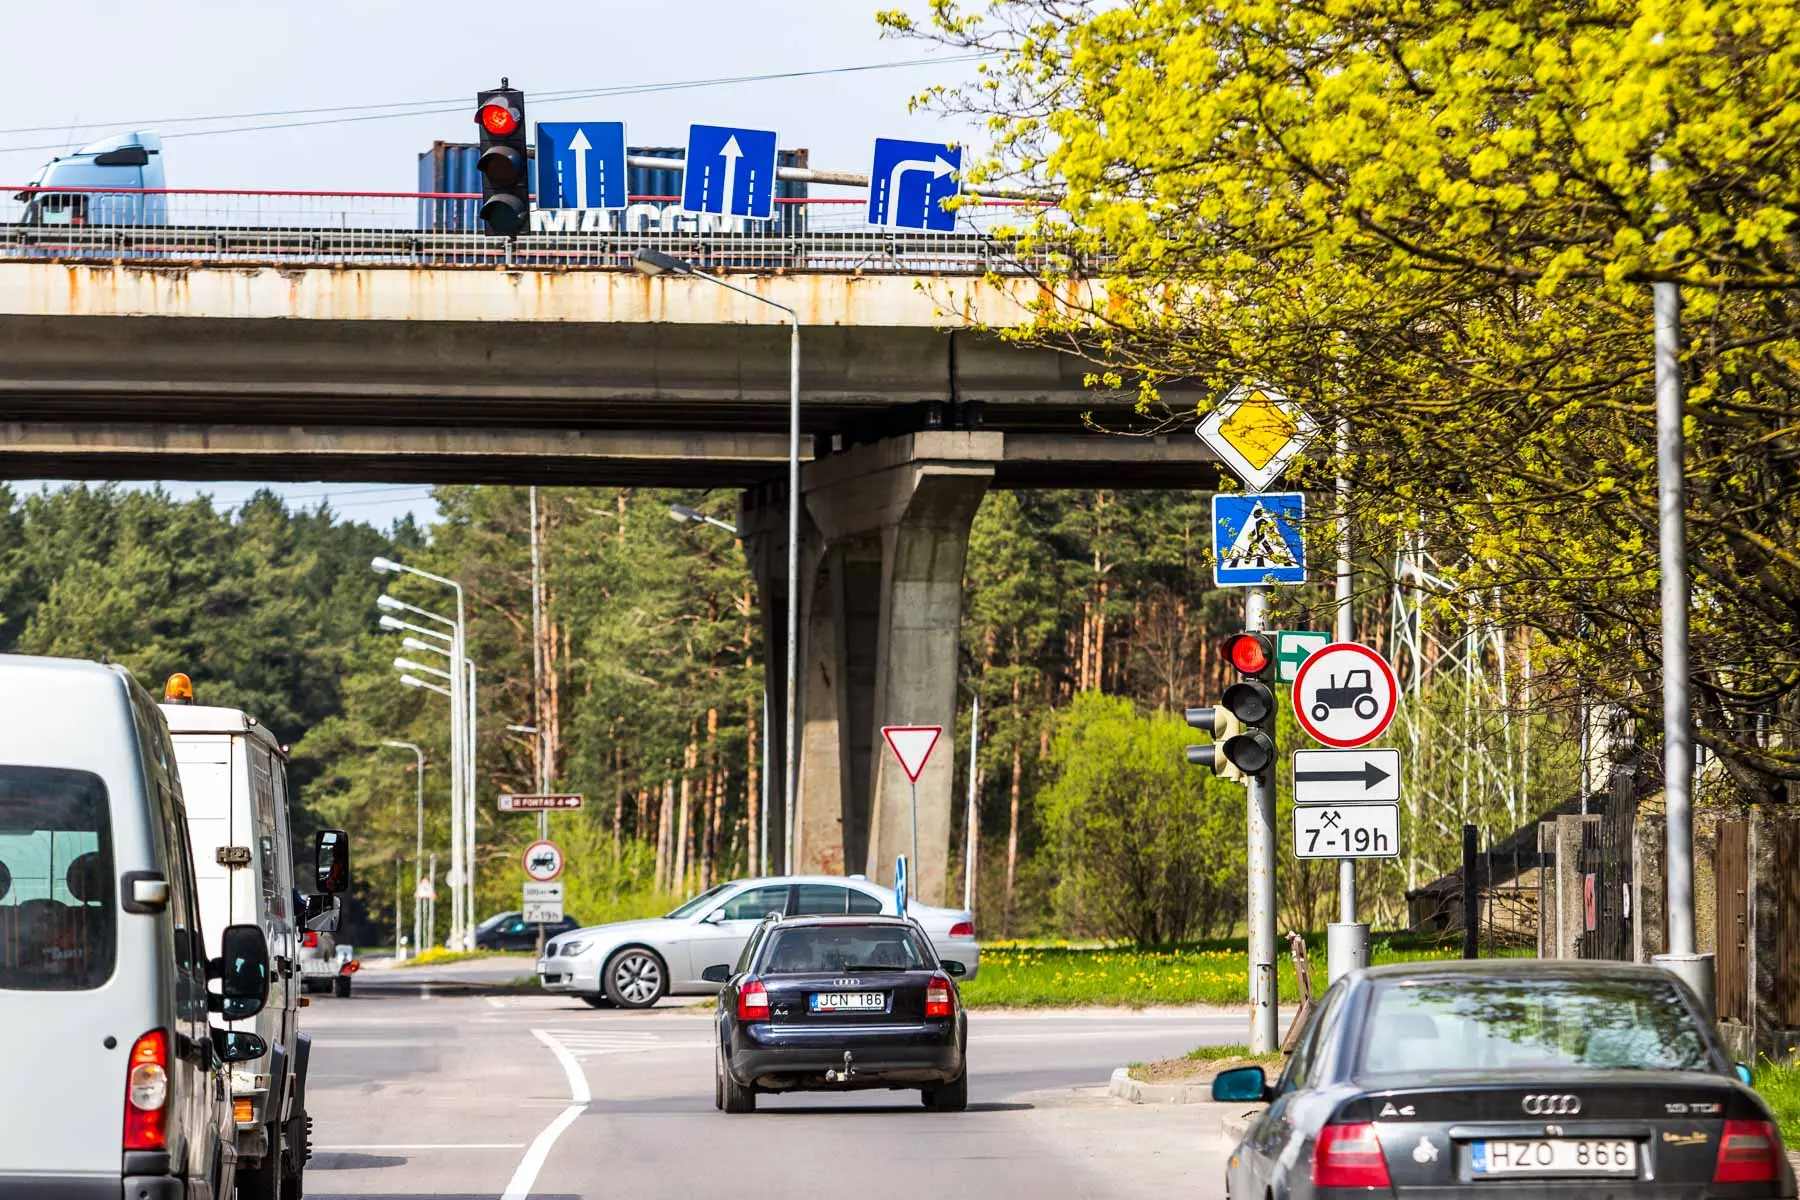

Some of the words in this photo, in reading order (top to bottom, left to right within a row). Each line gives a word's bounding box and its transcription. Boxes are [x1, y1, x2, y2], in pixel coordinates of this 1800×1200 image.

[626, 203, 744, 232] CGM
[819, 994, 849, 1006] JCN
[858, 993, 882, 1006] 186
[1492, 1141, 1553, 1167] HZO
[1577, 1141, 1628, 1166] 866
